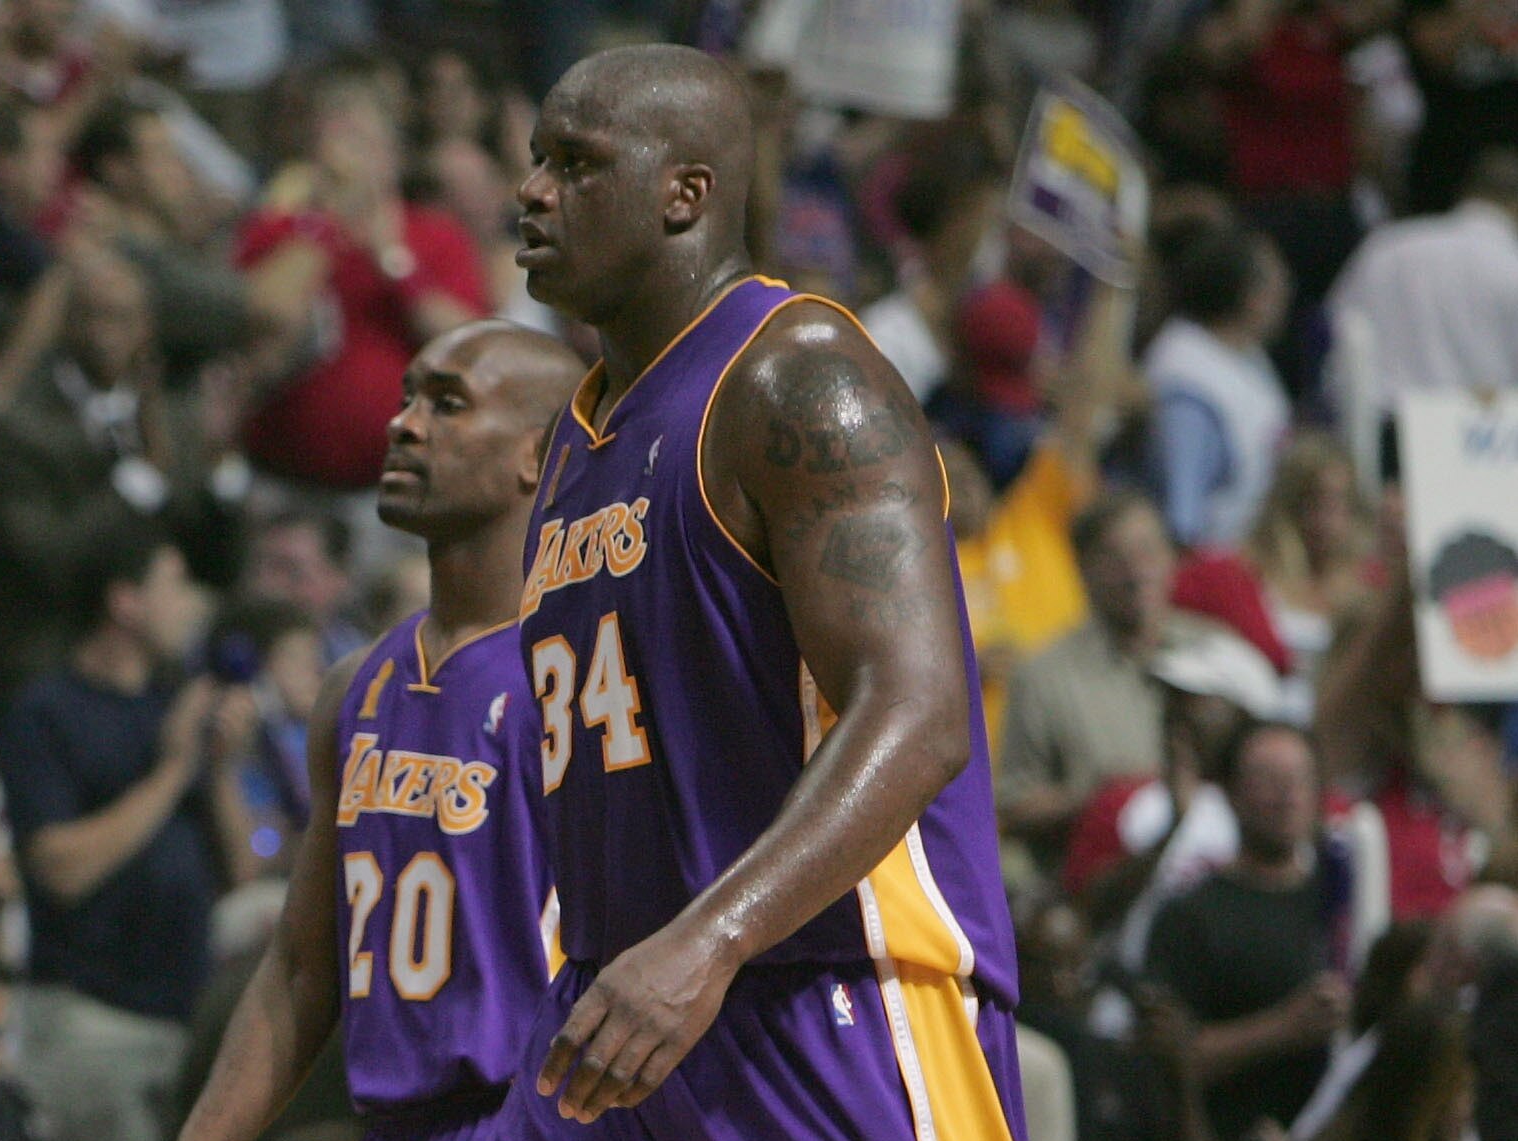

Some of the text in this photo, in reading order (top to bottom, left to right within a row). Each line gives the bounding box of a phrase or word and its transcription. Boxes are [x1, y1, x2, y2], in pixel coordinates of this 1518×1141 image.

[533, 611, 652, 796] 34
[336, 733, 498, 836] LAKERS
[344, 851, 456, 1001] 20
